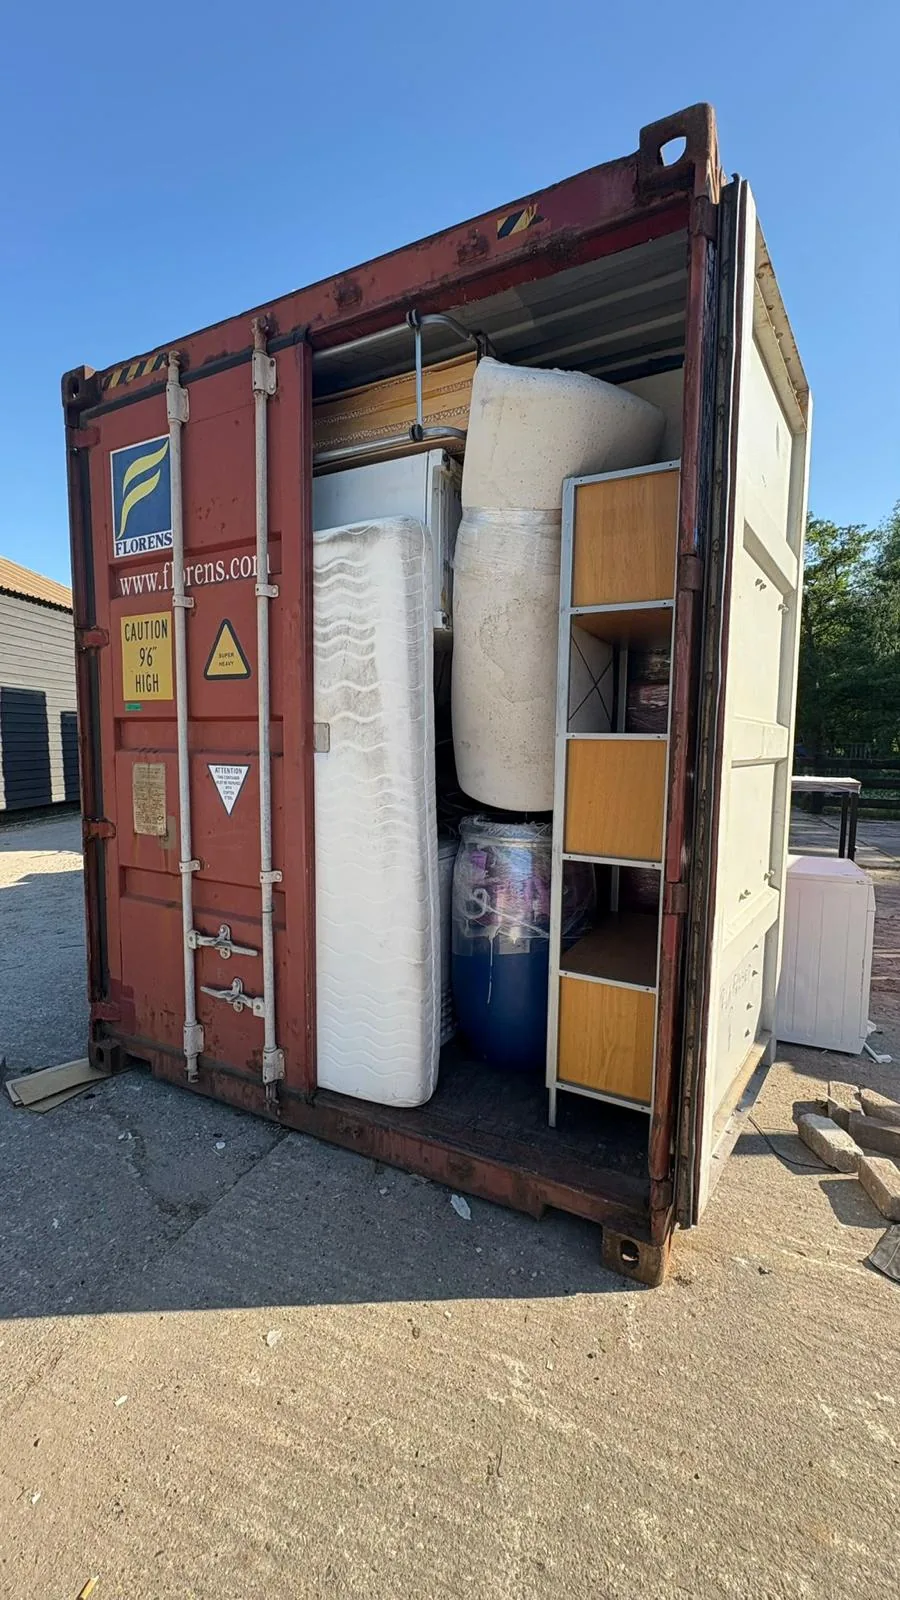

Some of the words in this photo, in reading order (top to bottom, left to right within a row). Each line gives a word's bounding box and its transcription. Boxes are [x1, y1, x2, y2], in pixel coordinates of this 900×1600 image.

[115, 532, 173, 556] FLORENS
[119, 552, 271, 596] www.flrens.co
[124, 619, 168, 642] CAUTION
[135, 673, 159, 693] HIGH
[214, 767, 243, 775] ATTENTION
